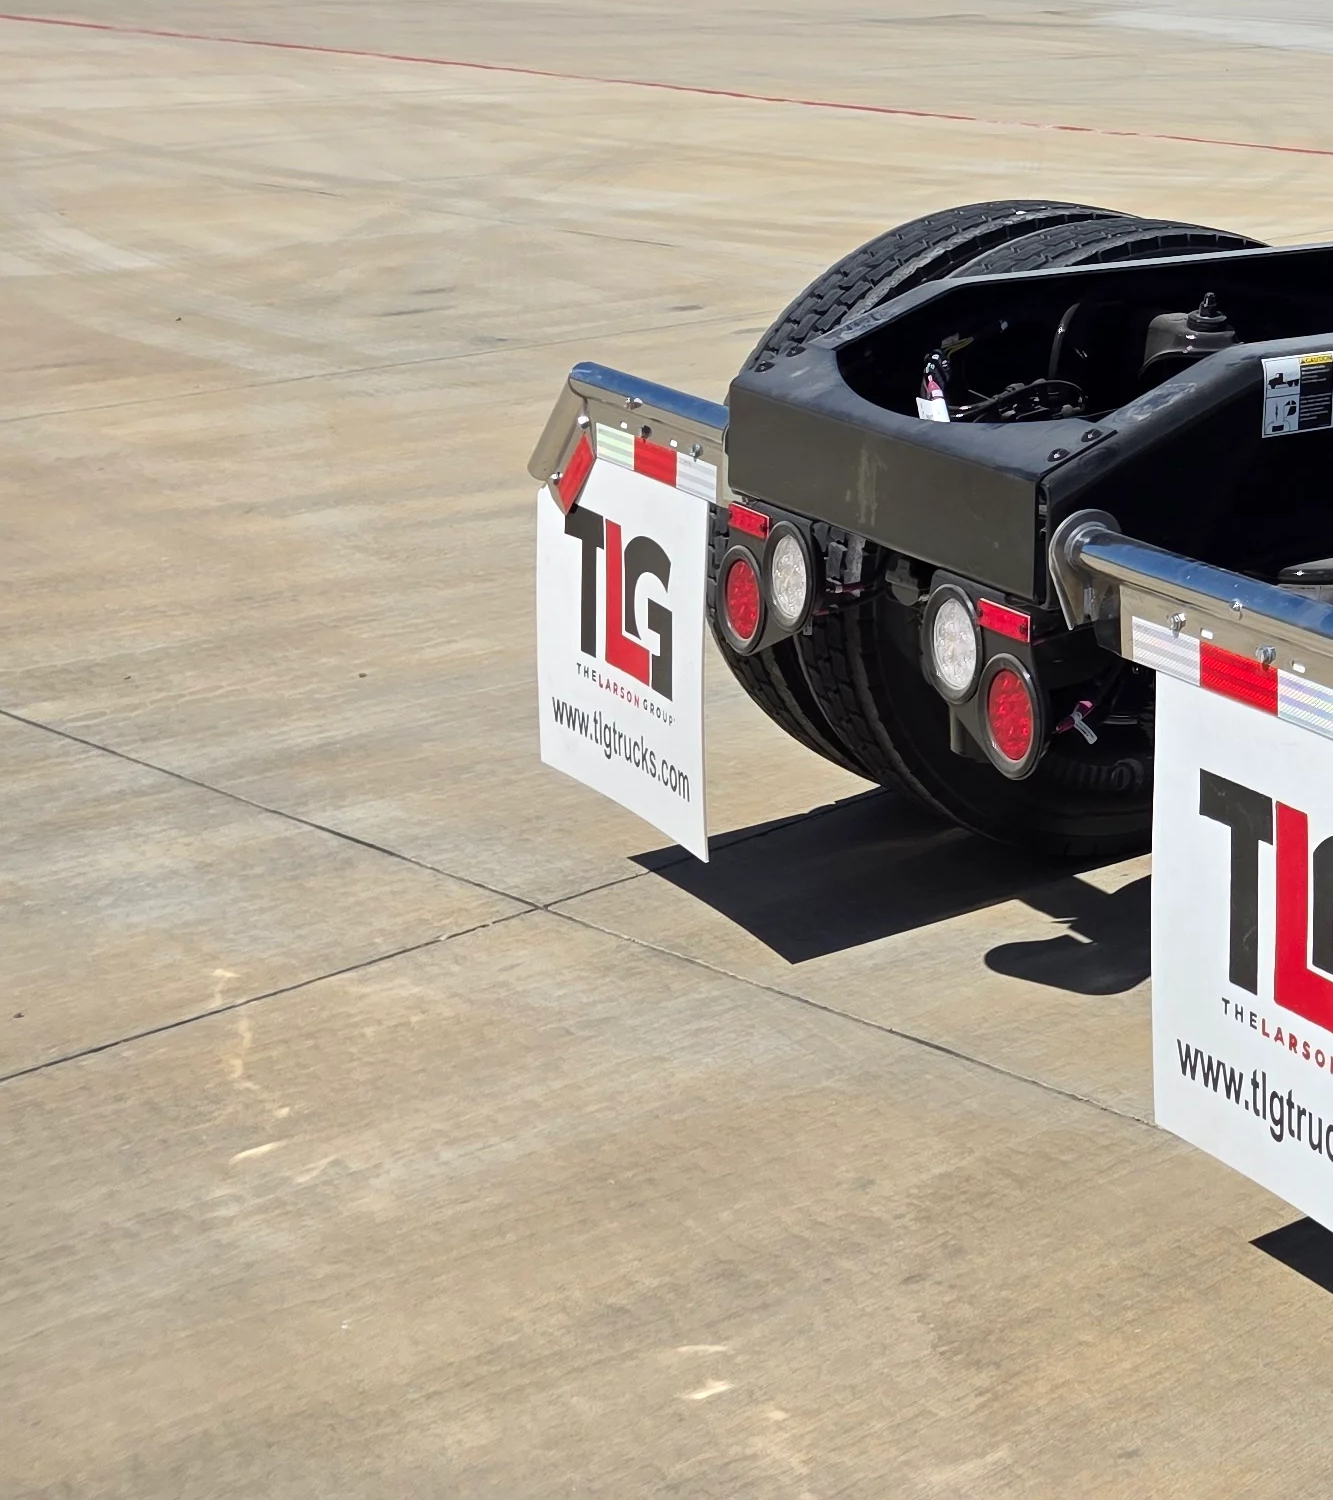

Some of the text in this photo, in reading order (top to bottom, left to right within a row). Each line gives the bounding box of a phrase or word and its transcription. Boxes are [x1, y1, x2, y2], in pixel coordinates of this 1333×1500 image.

[1305, 355, 1332, 363] CAUTION
[564, 502, 674, 702] TLG
[643, 698, 674, 727] GROUP
[552, 696, 691, 803] www.tlgtrucks.com
